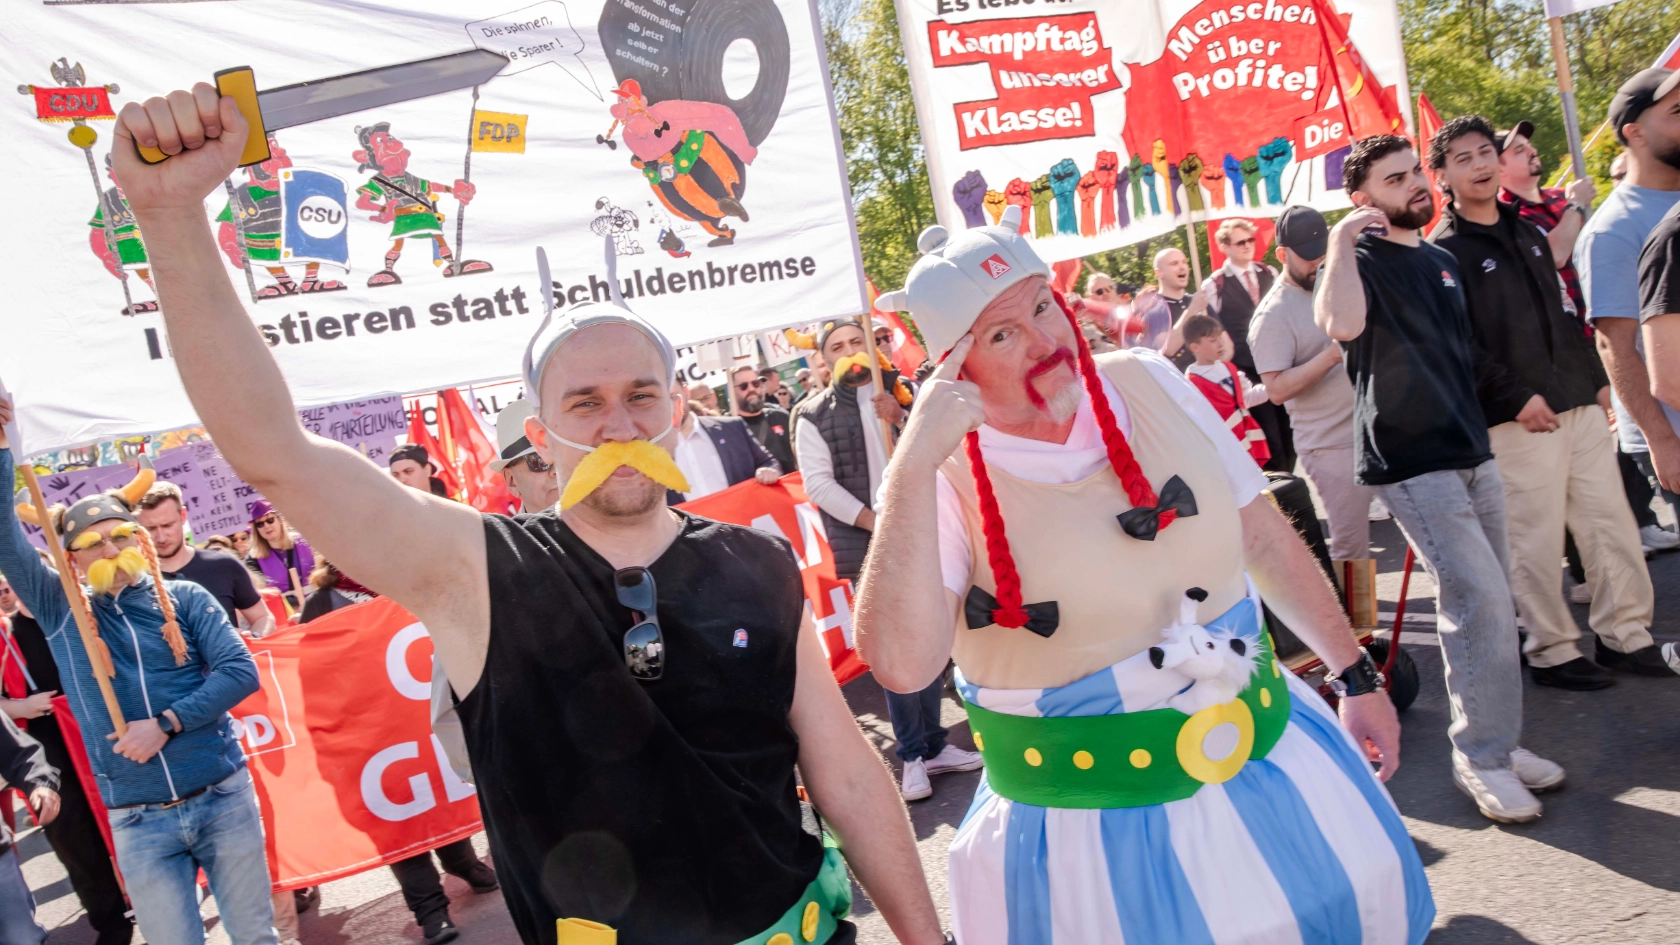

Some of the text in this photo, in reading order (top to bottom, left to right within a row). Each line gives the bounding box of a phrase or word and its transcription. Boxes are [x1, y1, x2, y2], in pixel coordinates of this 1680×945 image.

[668, 3, 686, 17] der
[481, 16, 553, 38] Die spinnen,
[627, 22, 665, 42] ab jetzt
[1167, 0, 1317, 62] Menschen
[518, 41, 554, 58] Sparer
[627, 39, 659, 55] selber
[937, 20, 1099, 61] Kampftag
[1206, 35, 1282, 64] über
[615, 48, 660, 73] schultern
[999, 63, 1109, 90] unserer
[1172, 58, 1319, 101] Profite!
[49, 93, 98, 112] CDU
[478, 121, 520, 143] FDP
[961, 101, 1083, 139] Klasse!
[1304, 118, 1344, 149] Die
[300, 205, 342, 225] CSU
[429, 285, 529, 326] statt
